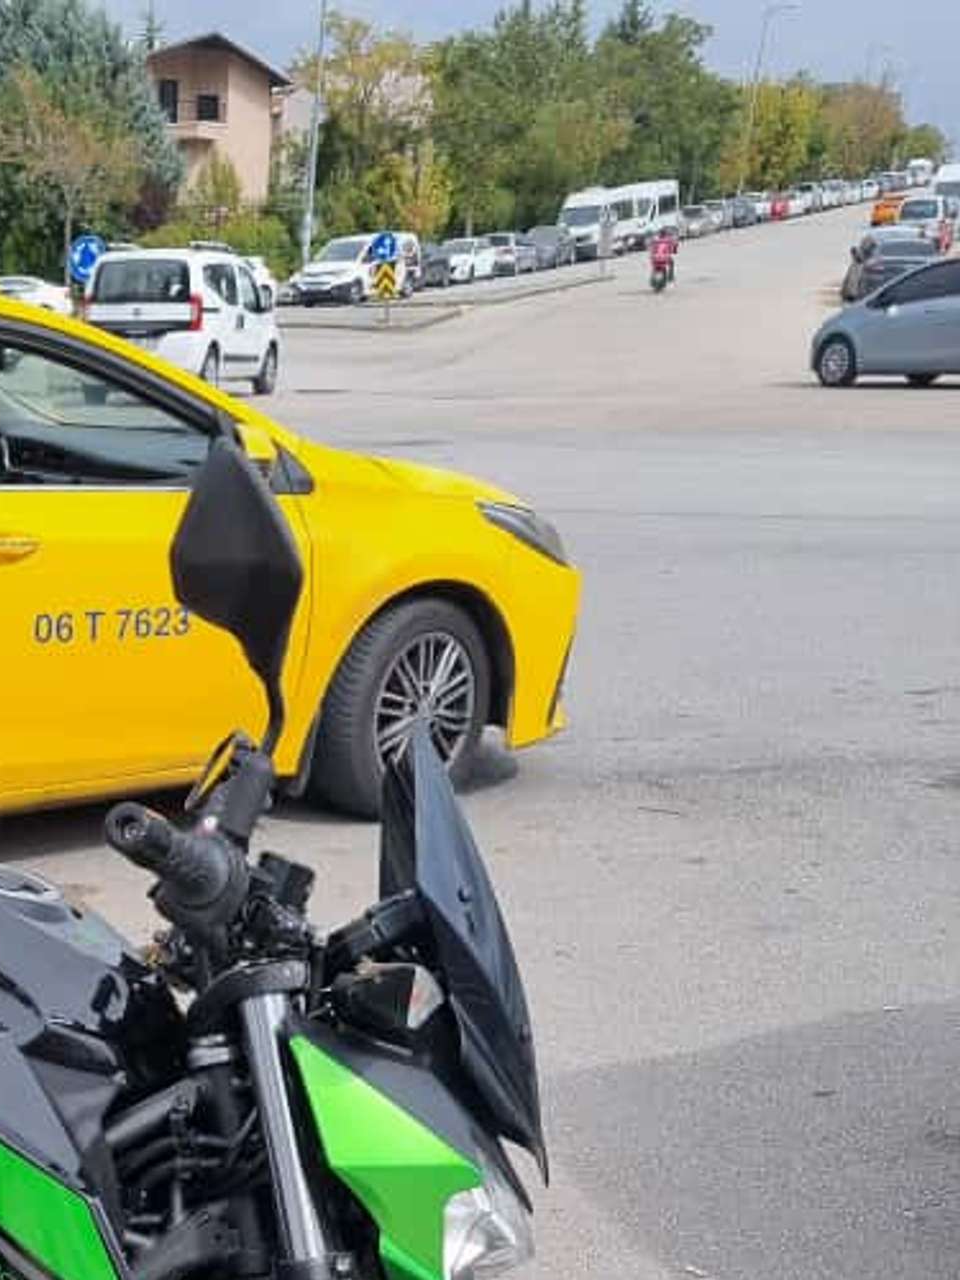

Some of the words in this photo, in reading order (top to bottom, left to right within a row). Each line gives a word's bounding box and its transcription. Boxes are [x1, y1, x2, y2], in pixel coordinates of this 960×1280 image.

[33, 613, 75, 643] 06
[85, 611, 107, 641] T
[115, 606, 190, 640] 7623
